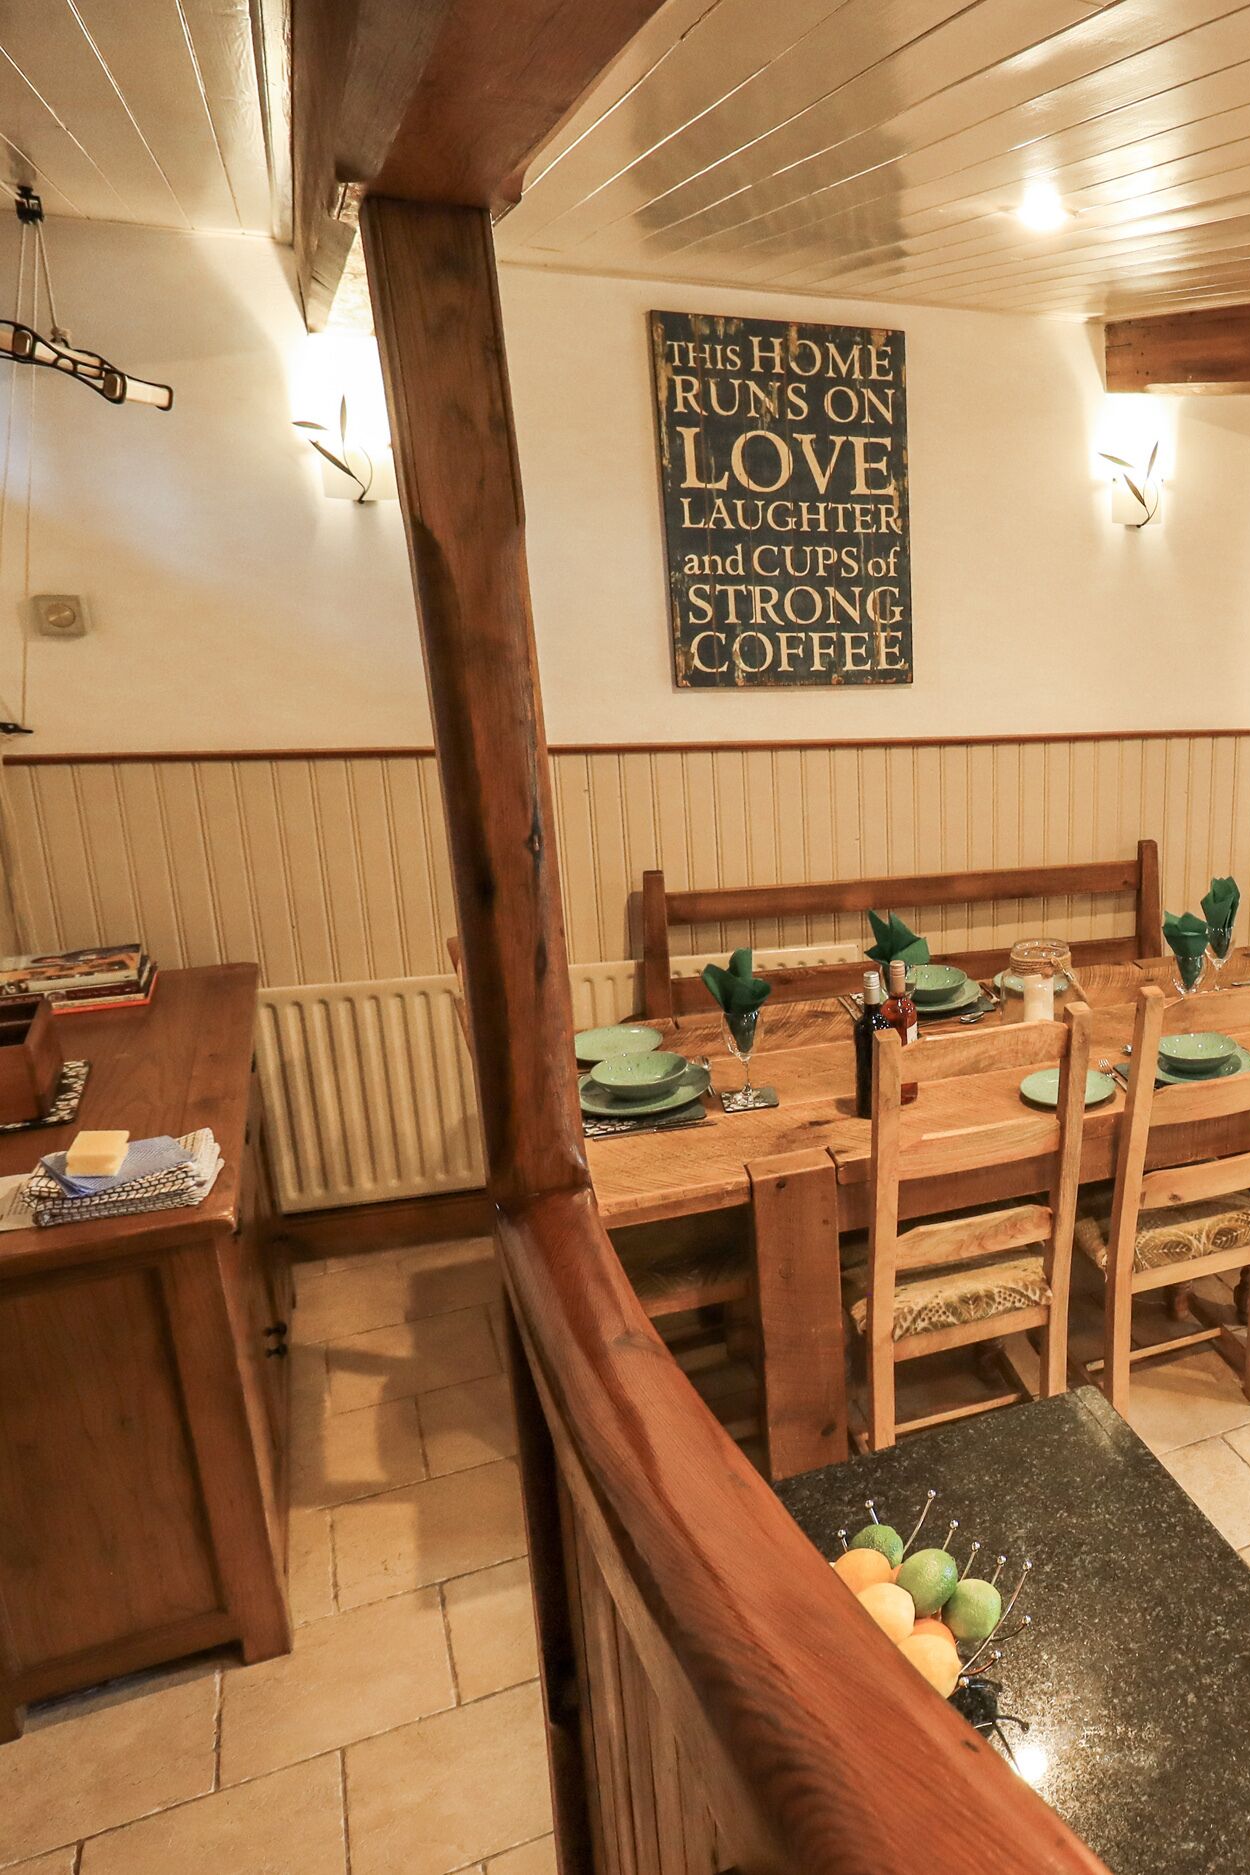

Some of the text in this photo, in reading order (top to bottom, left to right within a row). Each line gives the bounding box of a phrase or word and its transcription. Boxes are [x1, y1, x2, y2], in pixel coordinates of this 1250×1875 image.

[667, 336, 894, 381] THIS HOME
[672, 375, 896, 425] RUNS ON
[676, 426, 895, 496] LOVE
[679, 497, 903, 535] LAUGHTER
[683, 544, 900, 577] and CUPS of
[688, 584, 904, 626] STRONG
[689, 631, 906, 673] COFFEE
